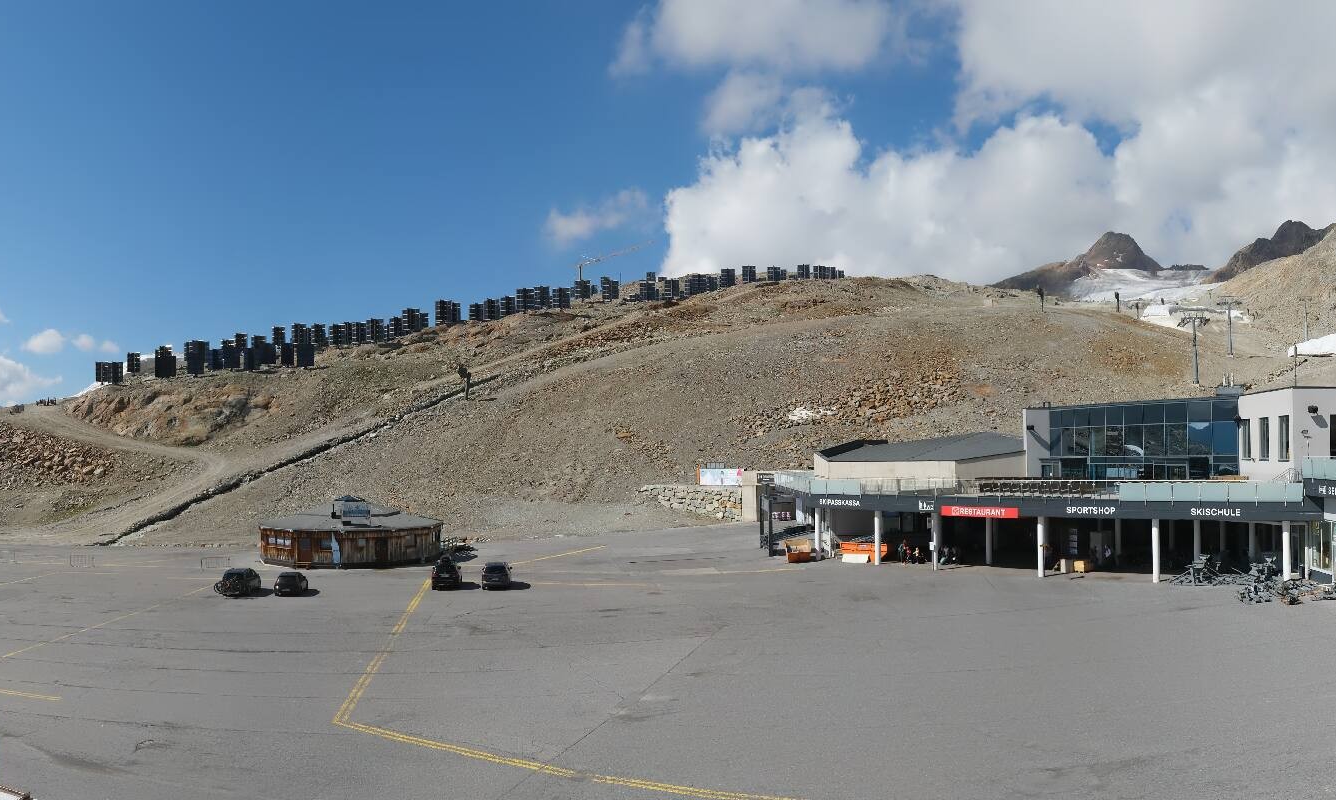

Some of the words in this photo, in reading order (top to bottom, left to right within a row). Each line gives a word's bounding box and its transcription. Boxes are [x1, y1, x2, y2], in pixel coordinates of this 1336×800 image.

[959, 507, 1006, 516] RESTAURANT
[1066, 506, 1116, 515] SPORTSHOP
[1190, 507, 1241, 517] SKISCHULE
